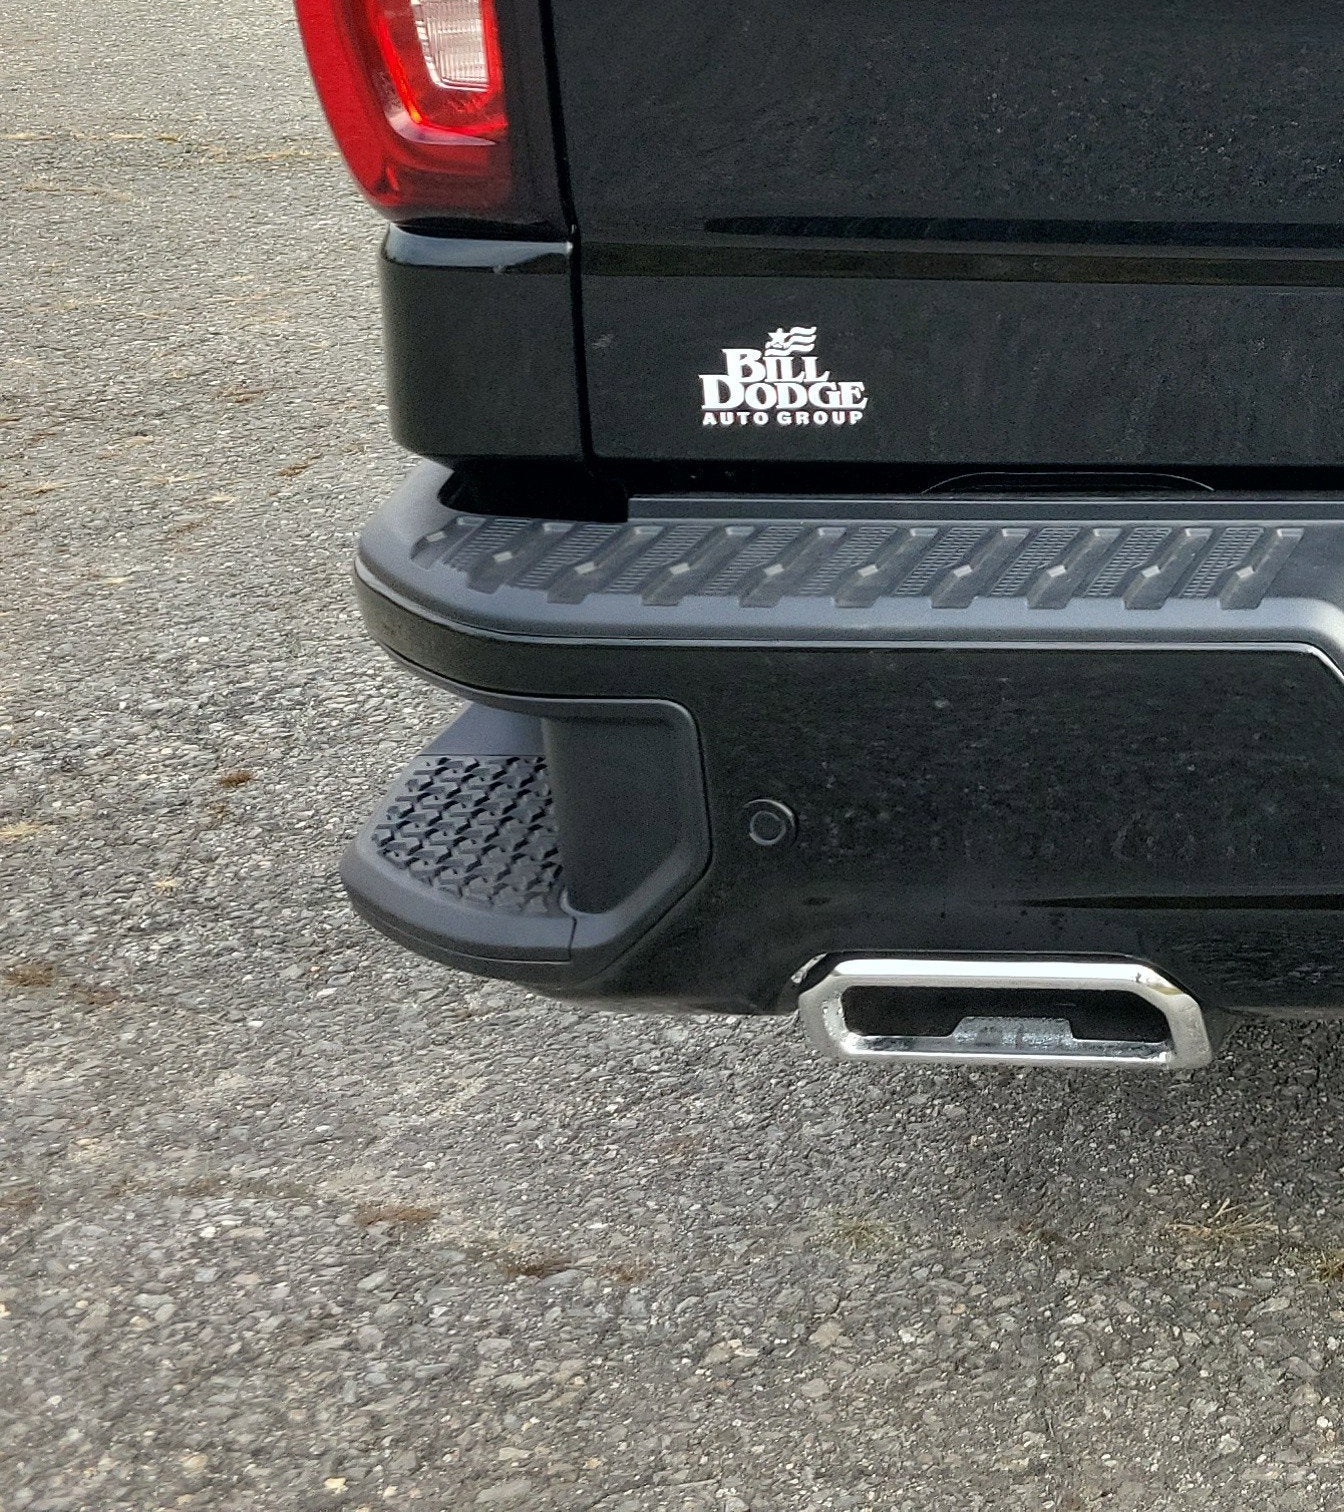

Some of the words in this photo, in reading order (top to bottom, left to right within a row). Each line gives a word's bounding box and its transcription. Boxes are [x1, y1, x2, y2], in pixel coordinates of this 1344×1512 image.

[722, 348, 831, 384] BILL
[698, 374, 869, 410] DODGE
[702, 411, 770, 426] AUTO
[776, 410, 864, 426] GROUP
